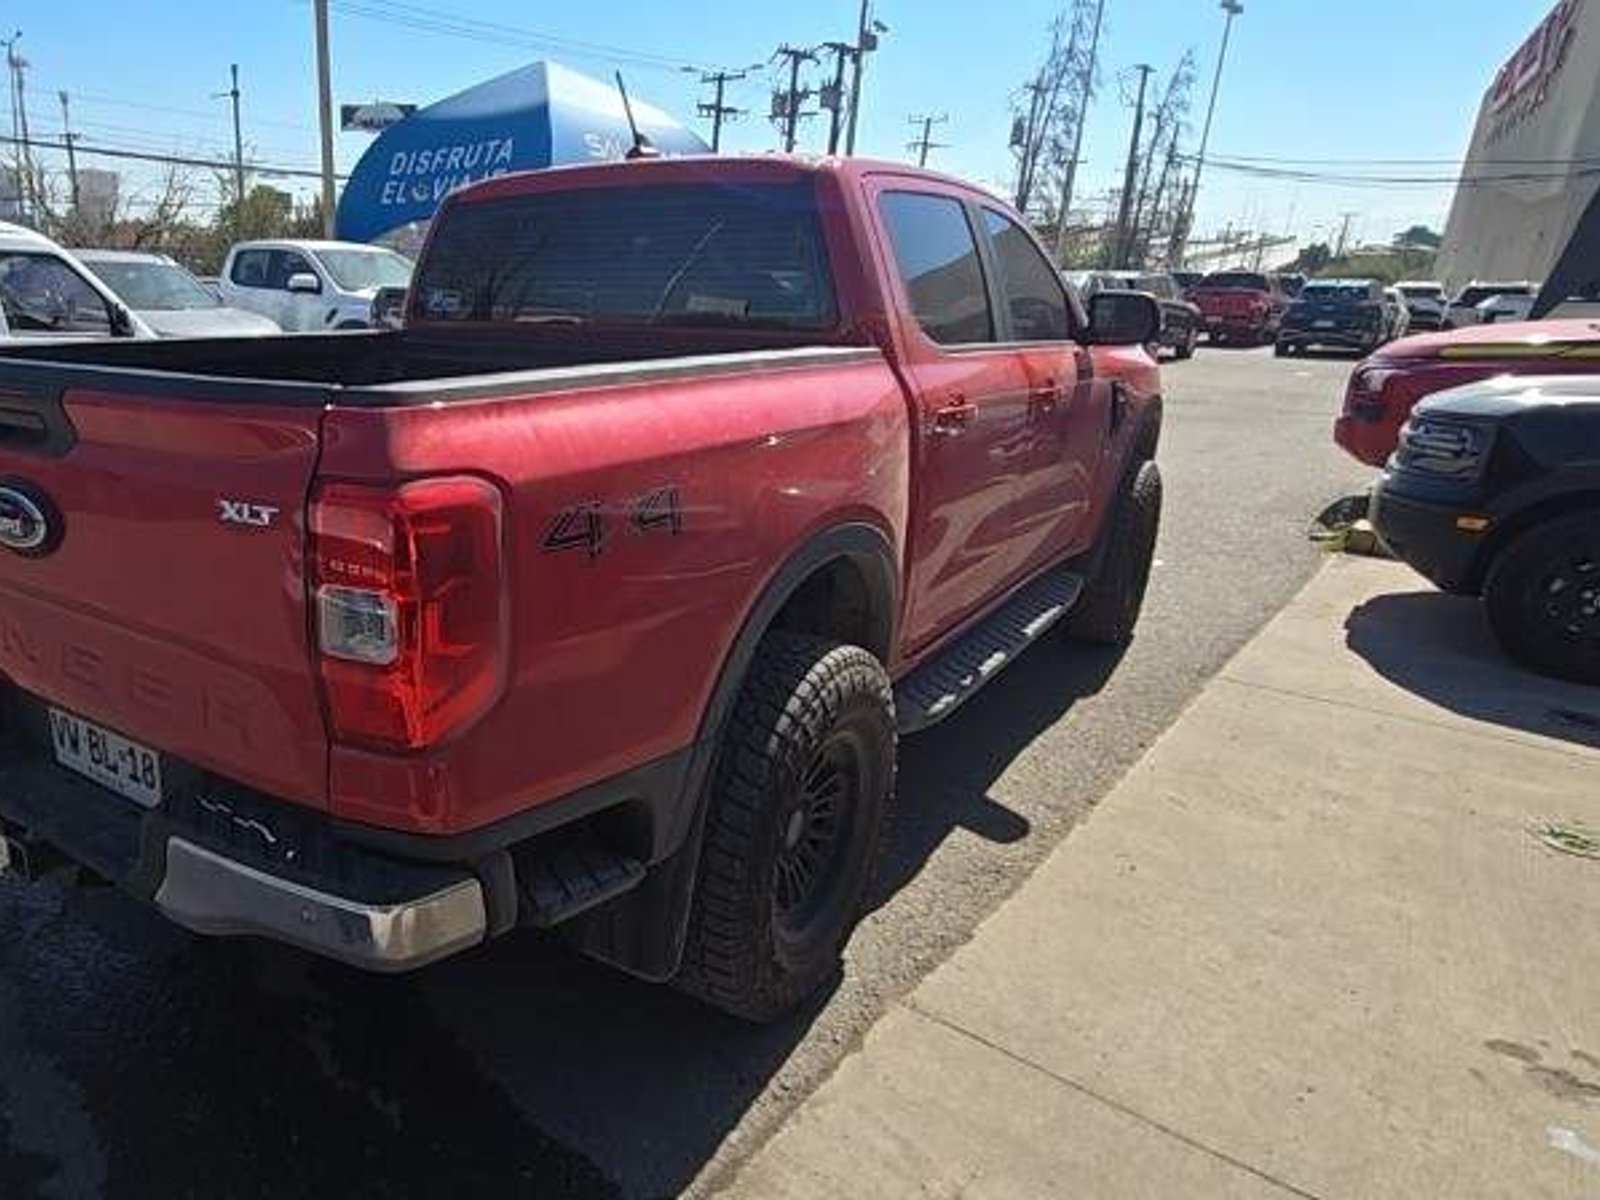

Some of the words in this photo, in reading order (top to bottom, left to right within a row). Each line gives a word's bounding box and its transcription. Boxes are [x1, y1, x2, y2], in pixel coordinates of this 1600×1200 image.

[390, 139, 513, 175] DISFRUTA
[381, 181, 407, 204] EL
[220, 500, 279, 525] XLT
